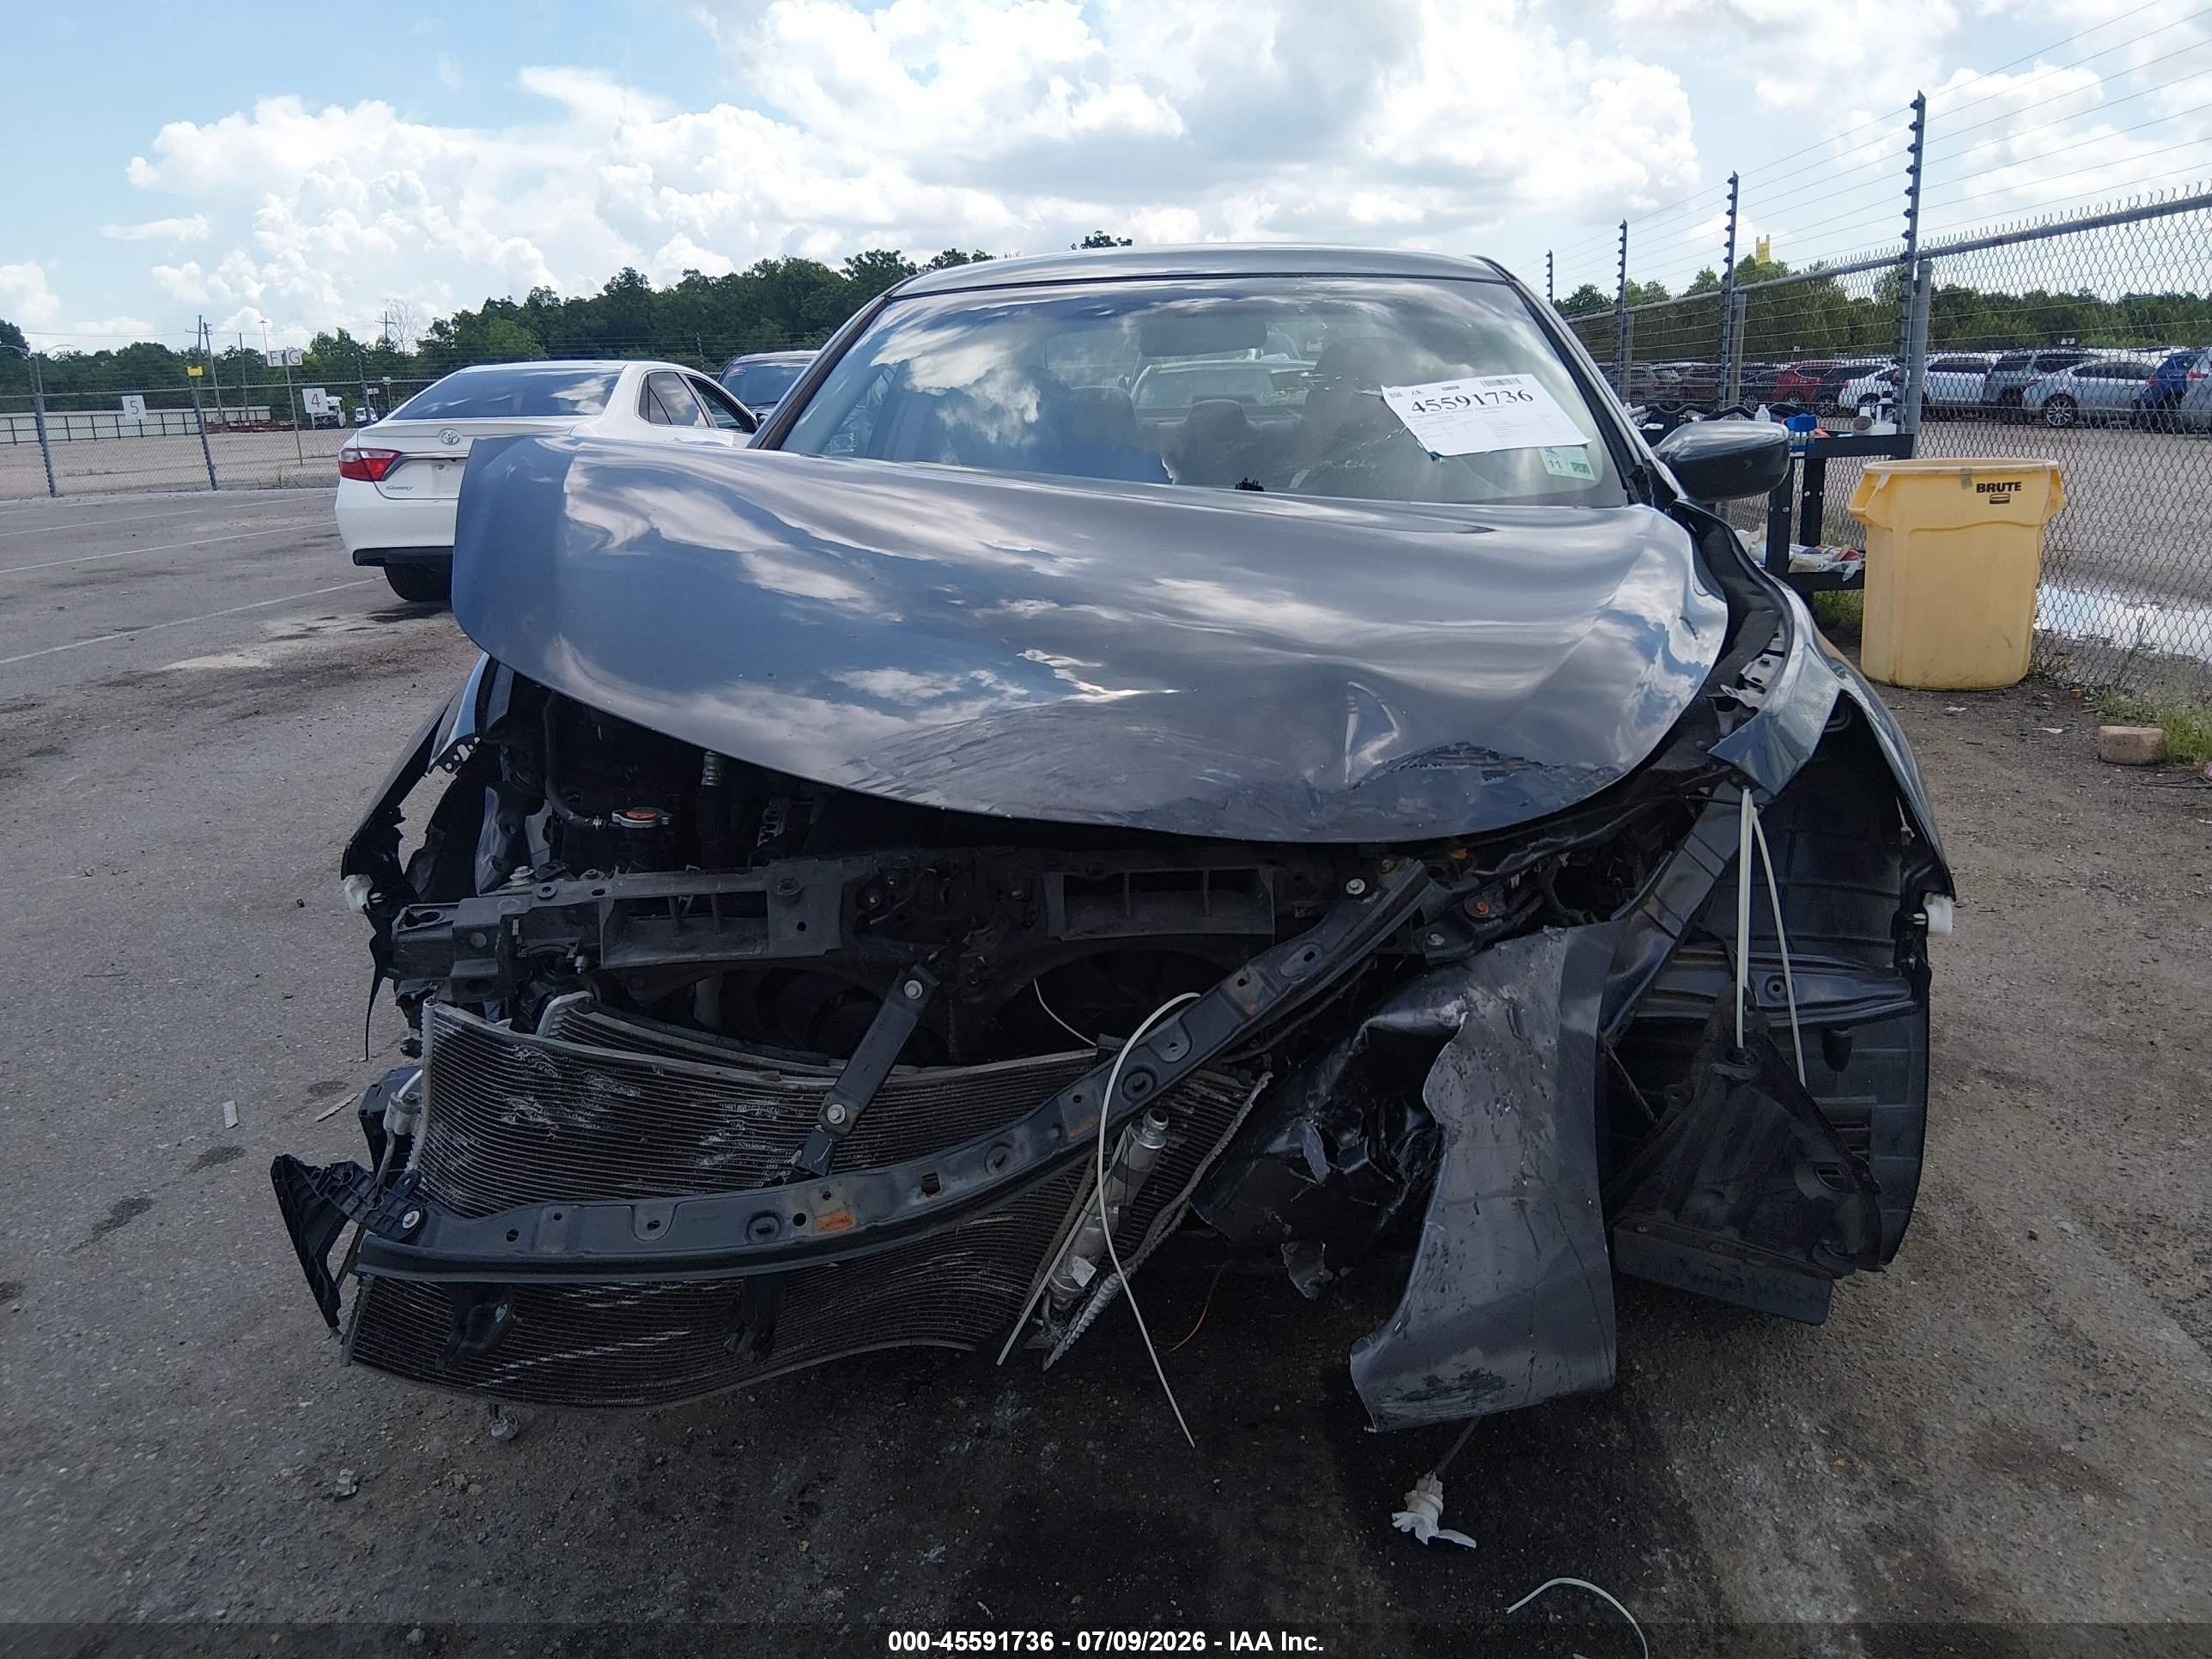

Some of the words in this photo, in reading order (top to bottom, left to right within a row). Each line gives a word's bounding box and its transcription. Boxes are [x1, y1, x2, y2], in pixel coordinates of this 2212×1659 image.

[270, 350, 277, 365] F
[289, 349, 301, 365] G
[130, 400, 139, 415] 5
[311, 392, 321, 408] 4
[1411, 388, 1534, 413] 45591736
[1976, 481, 2022, 494] BRUTE
